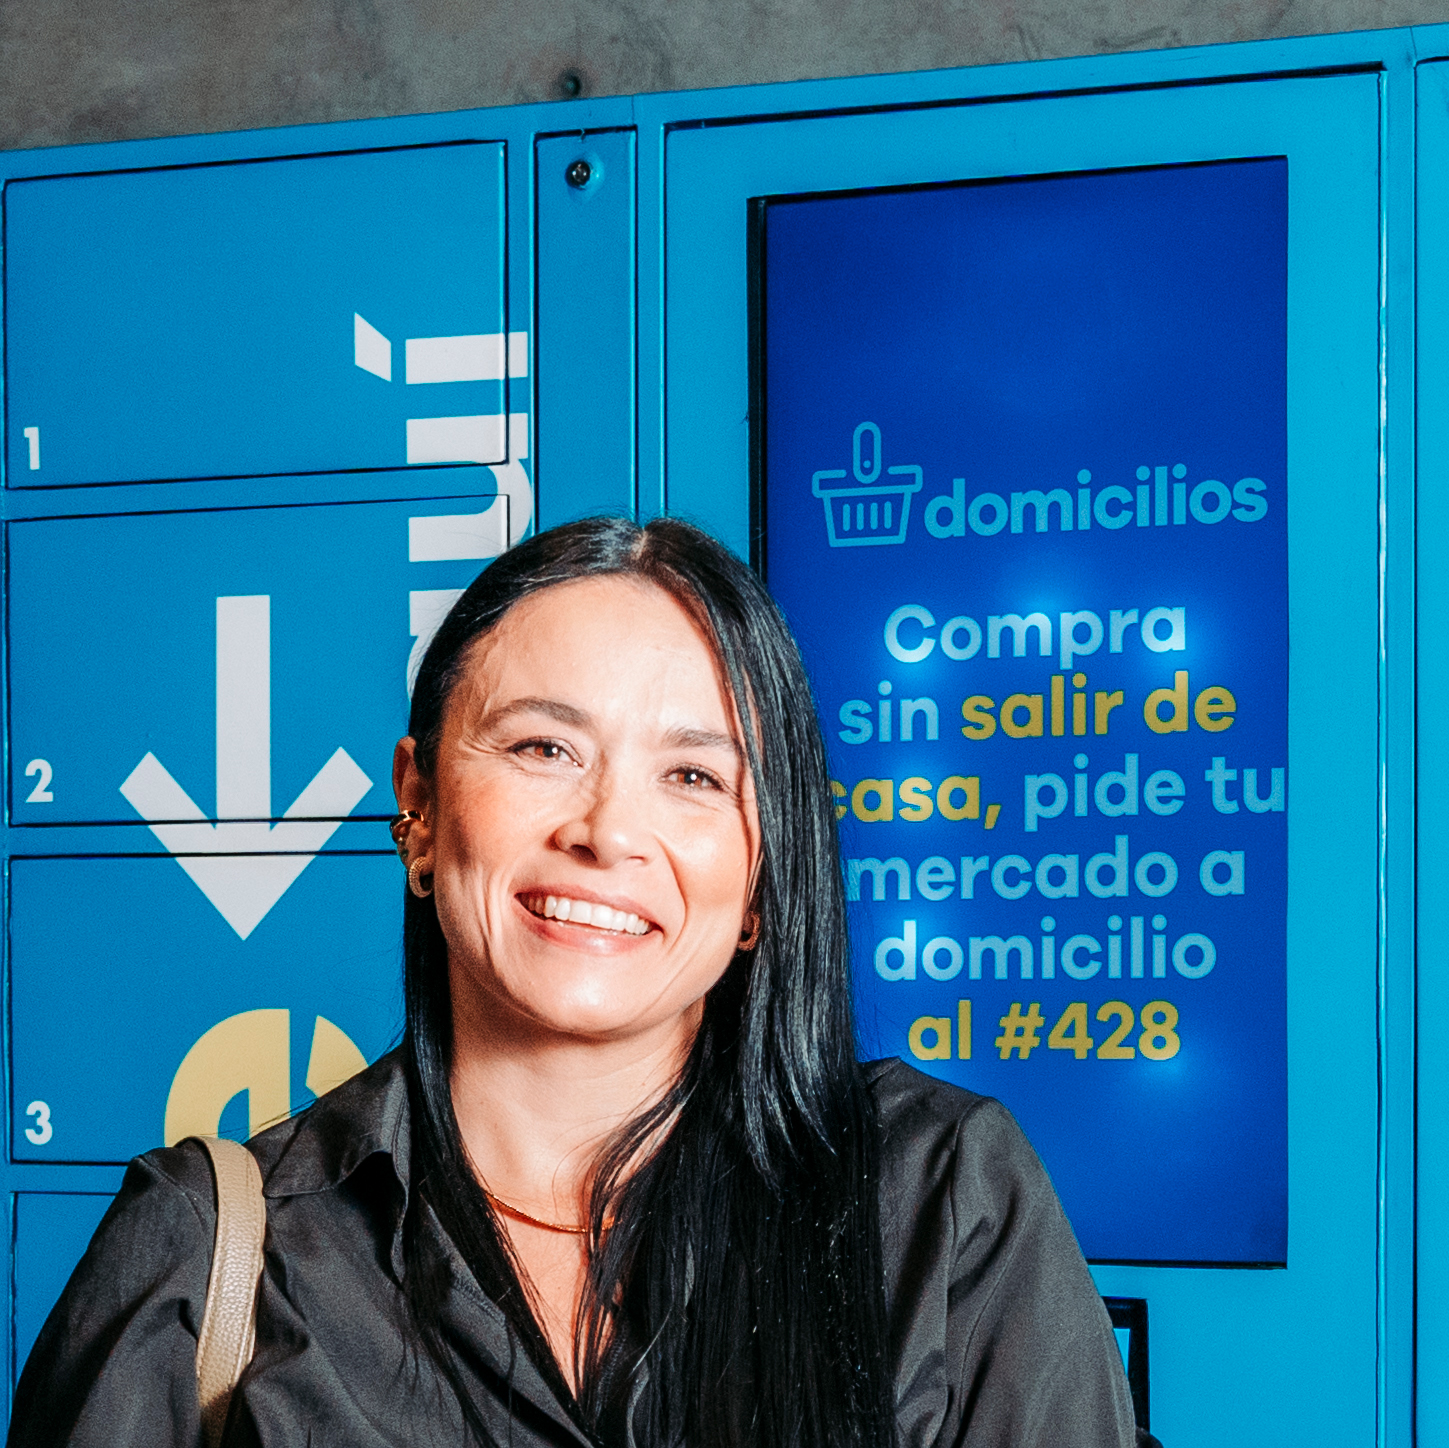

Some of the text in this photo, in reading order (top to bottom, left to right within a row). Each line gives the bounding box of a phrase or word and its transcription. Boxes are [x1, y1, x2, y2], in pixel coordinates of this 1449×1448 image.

[24, 426, 40, 471] 1
[924, 463, 1269, 540] domicilios
[884, 603, 1187, 670] Compra
[838, 670, 1237, 744] sin salir de
[25, 758, 54, 803] 2
[1024, 753, 1186, 832] pide
[1205, 756, 1286, 815] tu
[848, 834, 1245, 902] mercado a
[874, 914, 1217, 982] domicilio
[907, 999, 1181, 1061] al #428
[25, 1100, 53, 1146] 3
